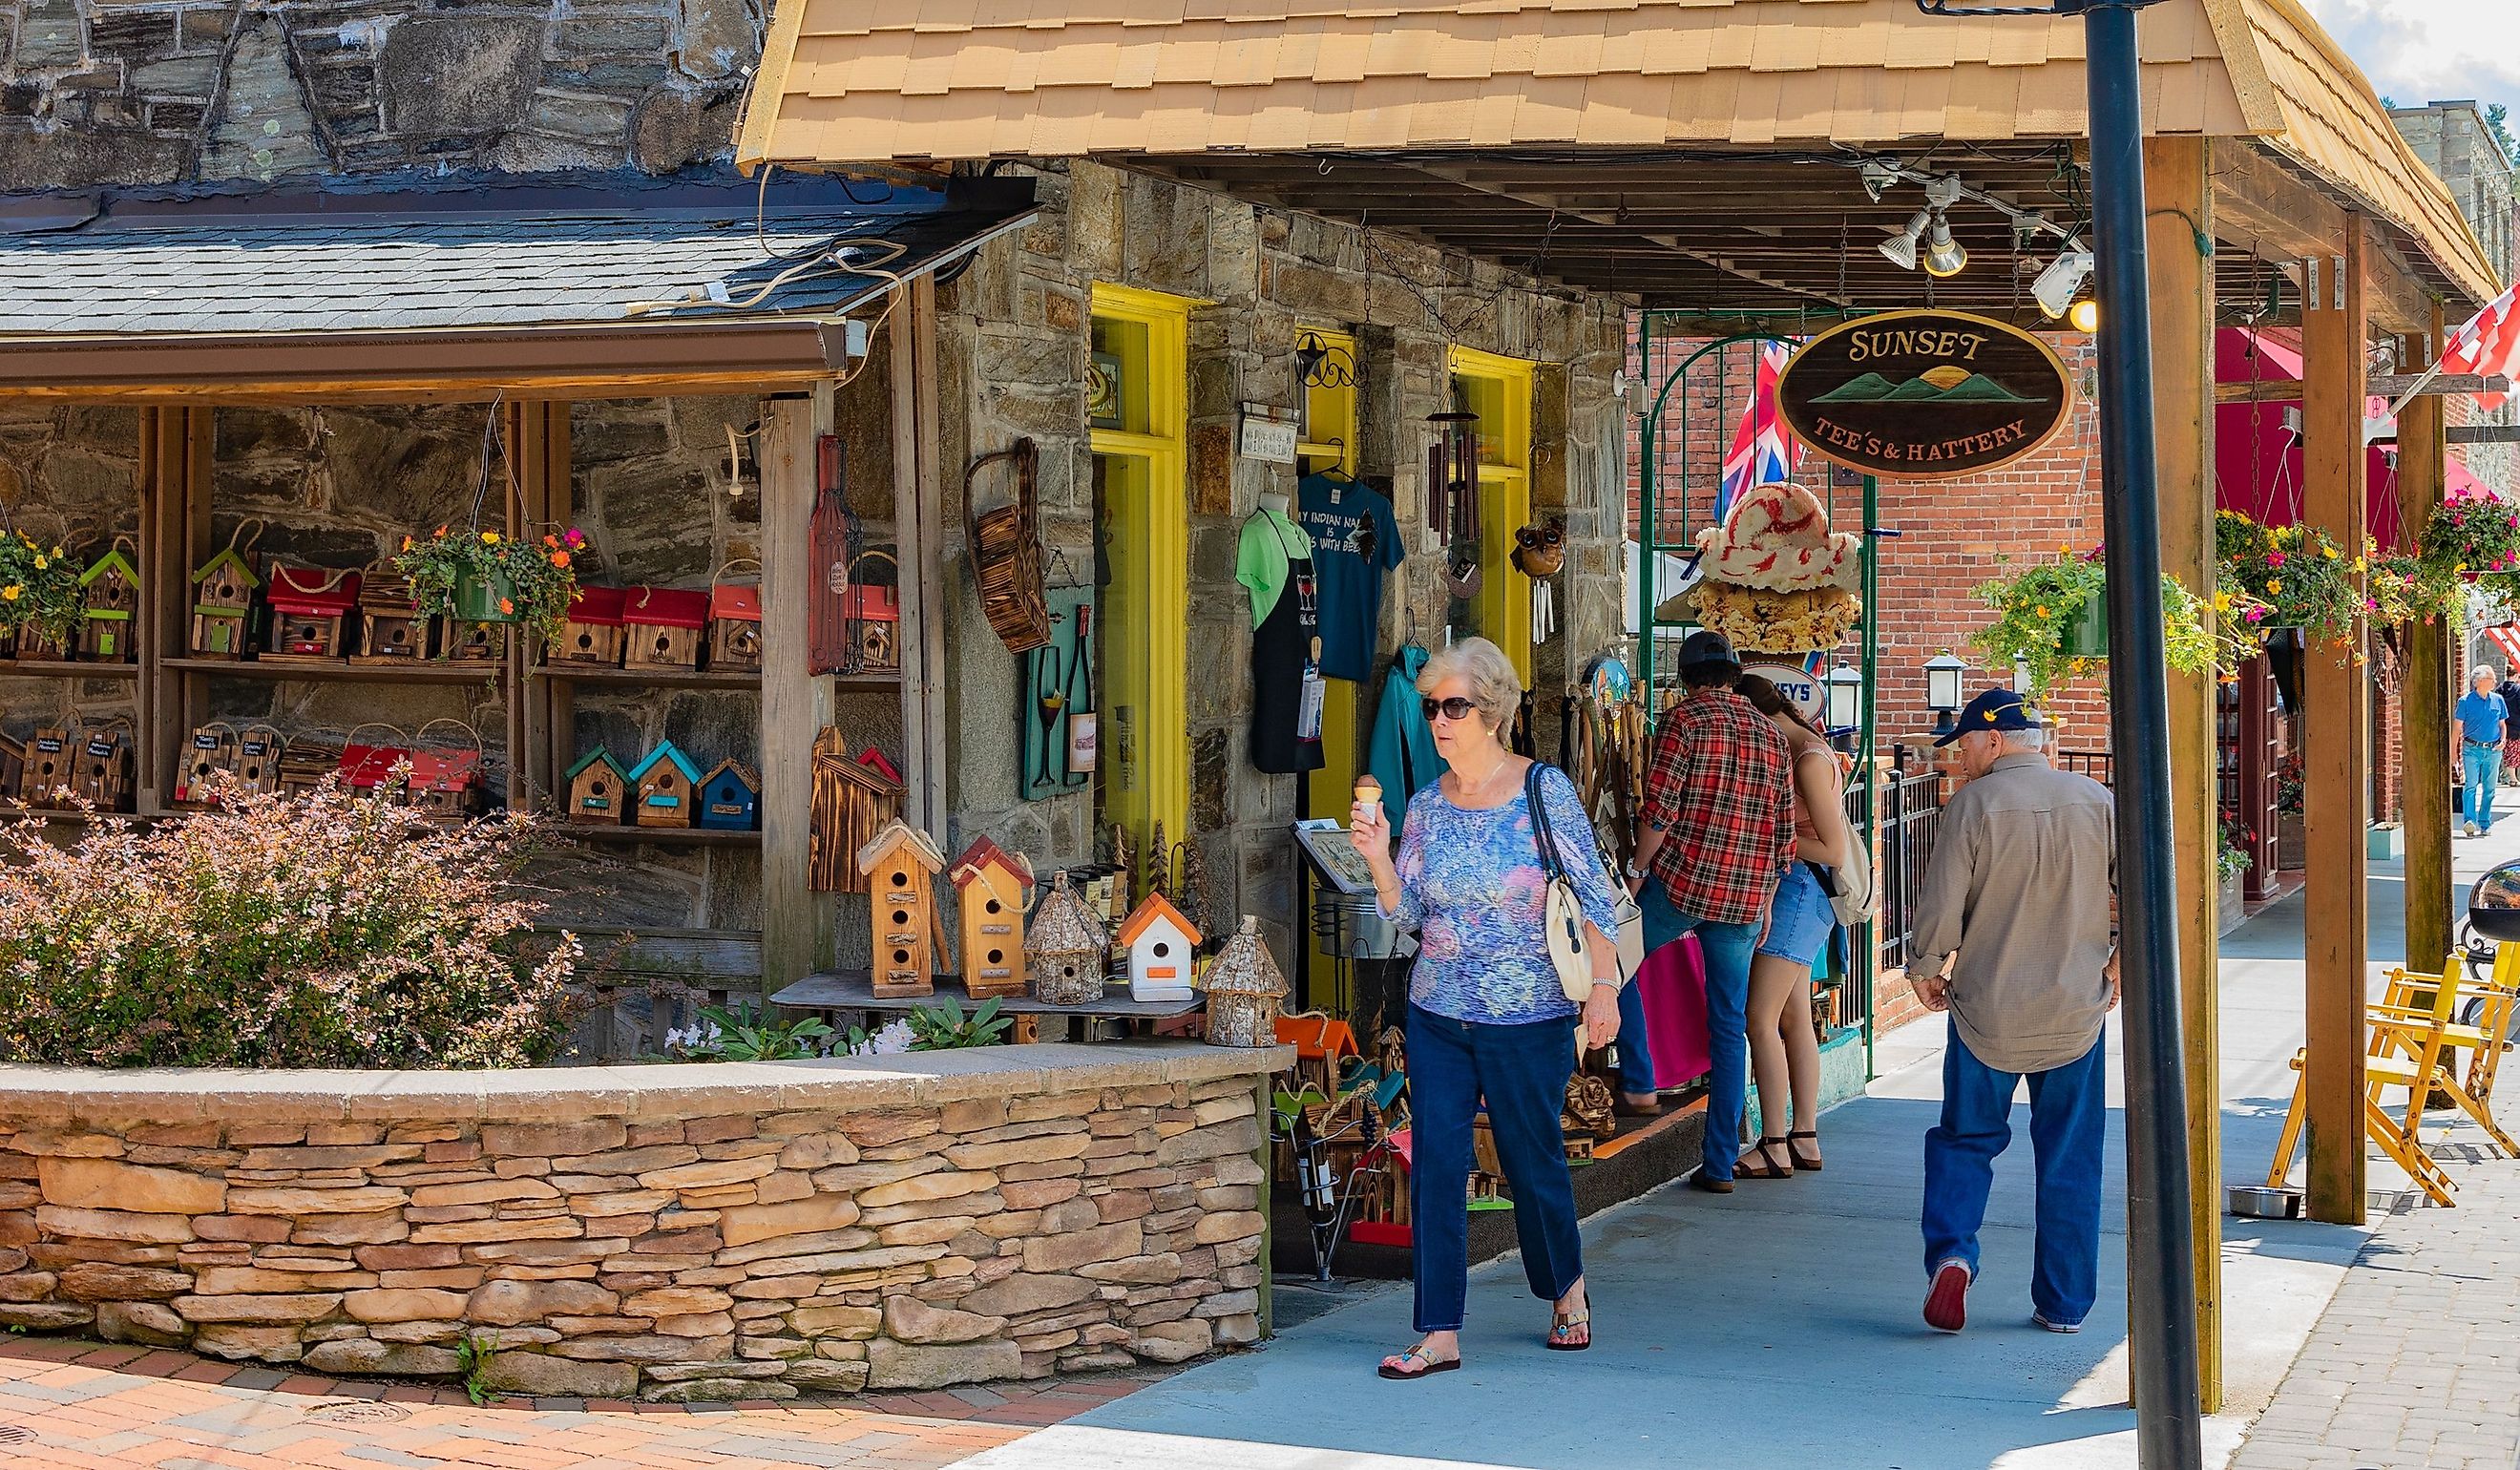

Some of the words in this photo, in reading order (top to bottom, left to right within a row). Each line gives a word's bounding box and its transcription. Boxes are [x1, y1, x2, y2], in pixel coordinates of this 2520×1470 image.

[1849, 330, 1989, 361] SUNSET
[1814, 417, 1881, 456] TEE'S
[1883, 442, 1900, 459] &
[1907, 419, 2027, 461] HATTERY
[1311, 512, 1341, 526] INDIAN
[1326, 527, 1334, 537] IS
[1319, 537, 1341, 552] WITH
